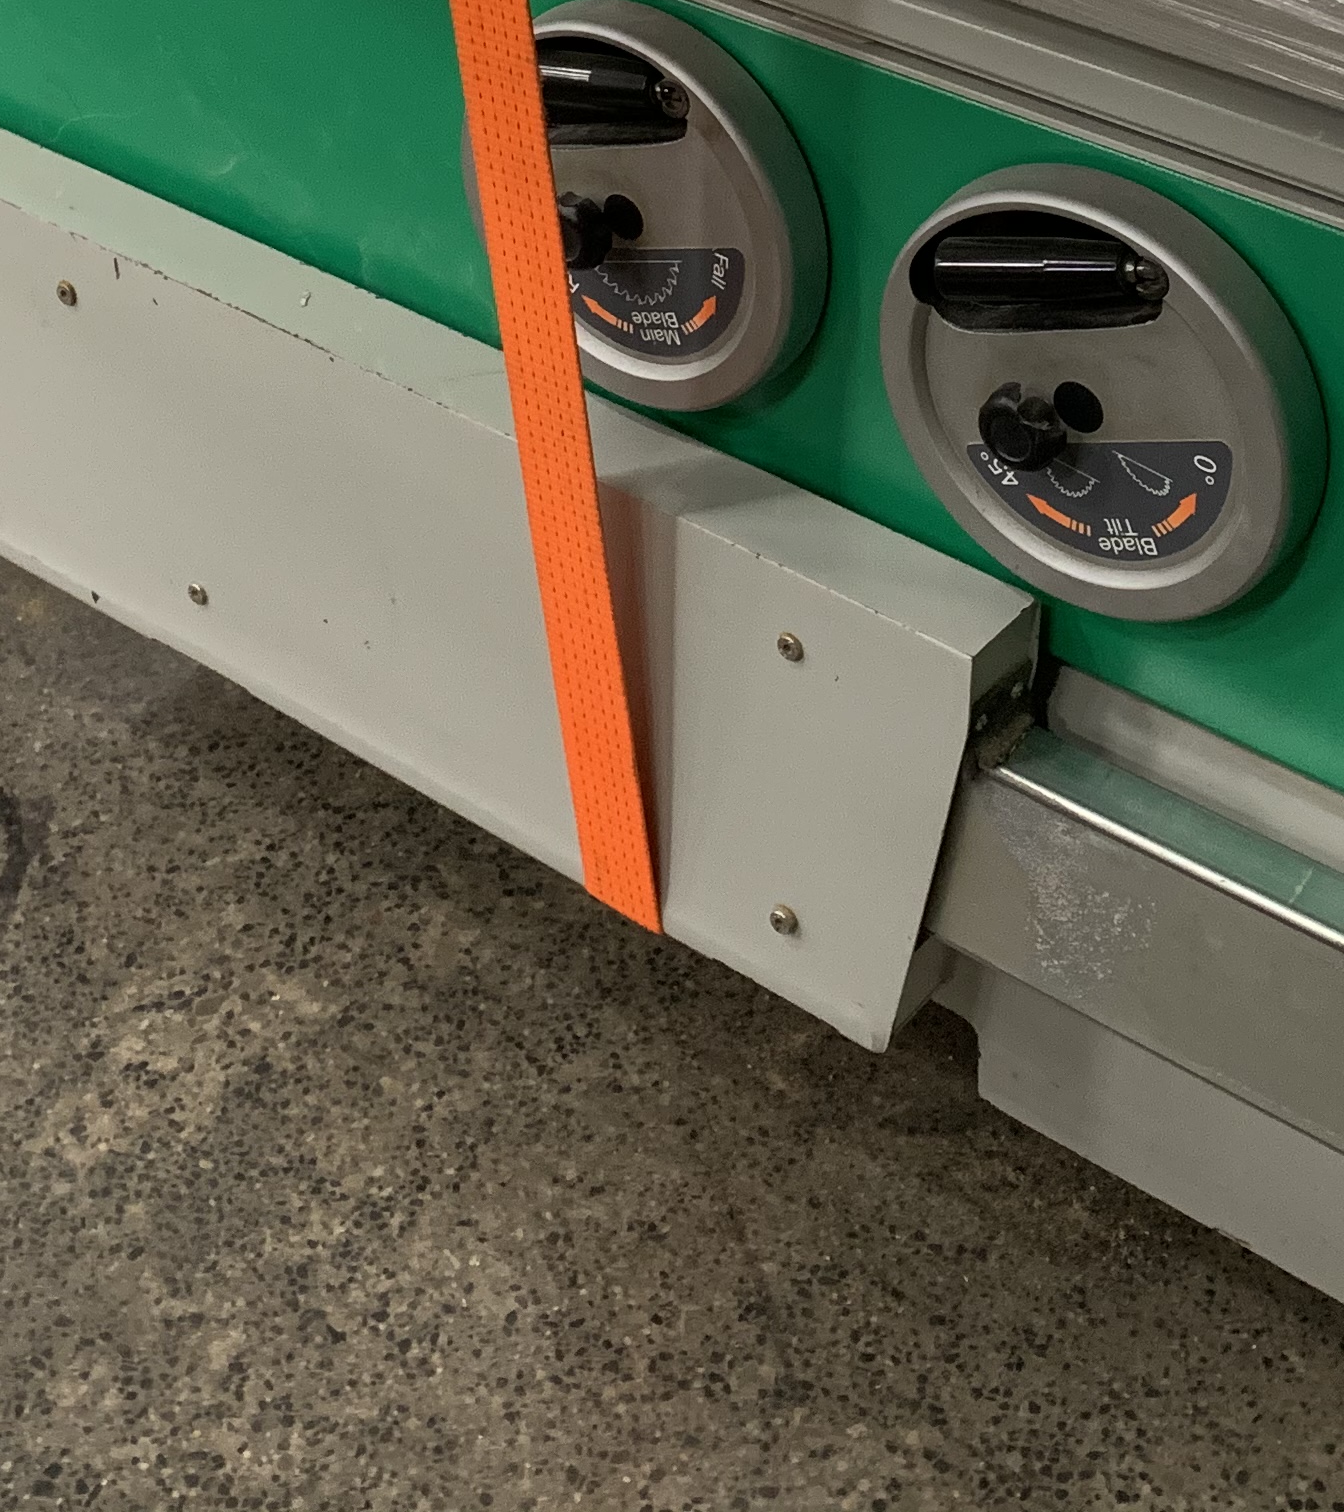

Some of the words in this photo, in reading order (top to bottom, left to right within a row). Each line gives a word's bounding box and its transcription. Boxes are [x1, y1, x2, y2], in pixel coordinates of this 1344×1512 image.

[710, 252, 729, 290] Fall
[630, 311, 679, 328] Blade
[639, 329, 681, 346] Main
[1103, 518, 1138, 536] Tilt
[1097, 536, 1158, 556] Blade
